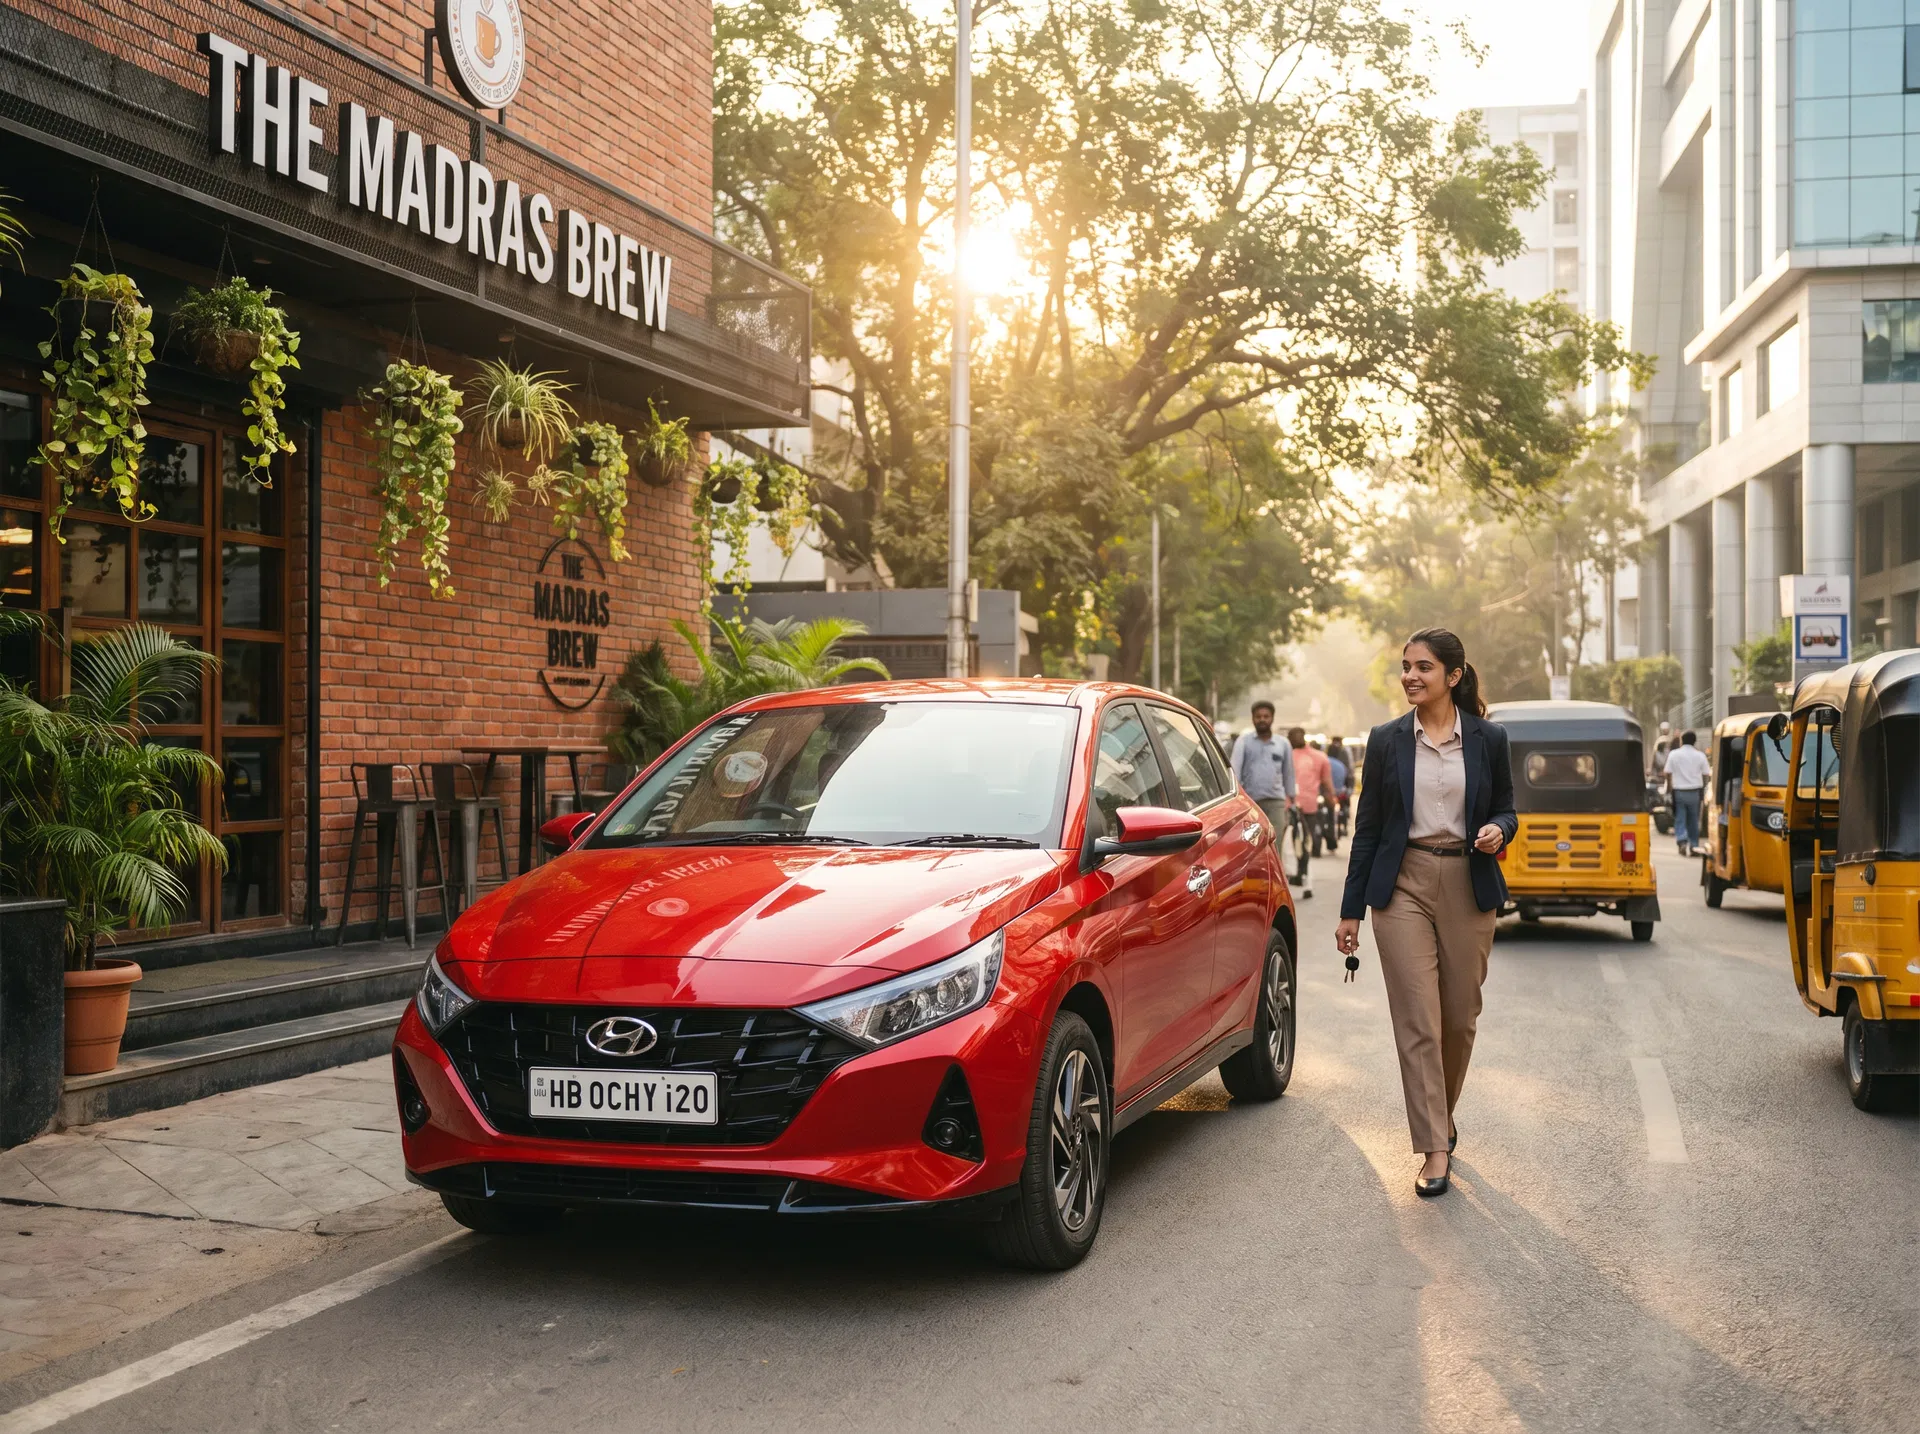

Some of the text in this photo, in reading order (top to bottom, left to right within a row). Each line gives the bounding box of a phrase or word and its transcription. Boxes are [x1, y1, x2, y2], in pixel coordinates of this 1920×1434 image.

[206, 33, 672, 332] THE MADRAS BREW
[562, 553, 585, 580] THE
[534, 581, 610, 629] MADRAS
[547, 628, 599, 669] BREW
[550, 1079, 582, 1109] HB
[666, 1084, 709, 1114] i20
